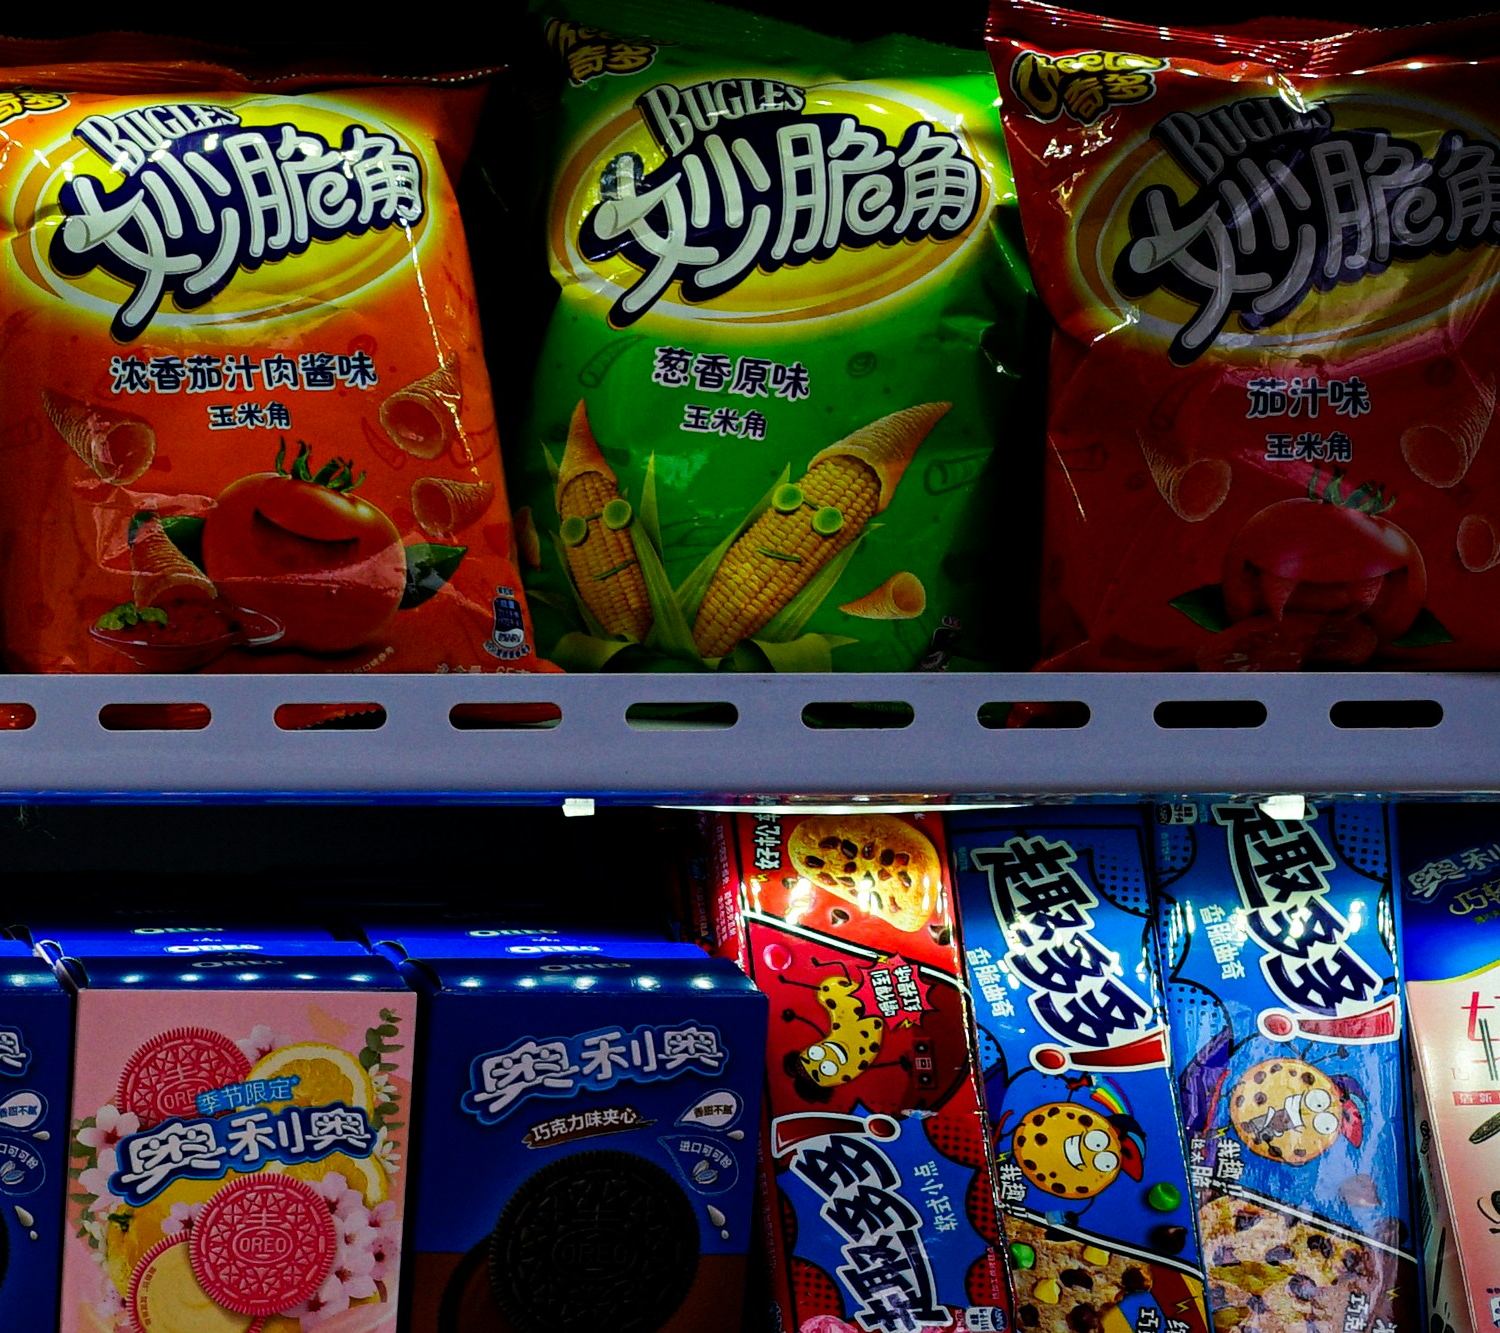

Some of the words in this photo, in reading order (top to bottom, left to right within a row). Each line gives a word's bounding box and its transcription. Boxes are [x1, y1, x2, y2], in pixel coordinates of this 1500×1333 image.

[86, 104, 241, 172] BUGLES
[61, 123, 424, 341] 妙脆角
[586, 117, 980, 327] 妙脆角
[111, 354, 377, 392] 浓香茄汁肉酱味
[652, 346, 810, 400] 葱香原味
[207, 402, 291, 431] 玉米角
[1248, 377, 1370, 420] 茄汁味
[196, 1079, 292, 1114] 季节限定
[531, 1108, 638, 1144] 巧克力味夹心
[239, 1235, 287, 1254] OREO
